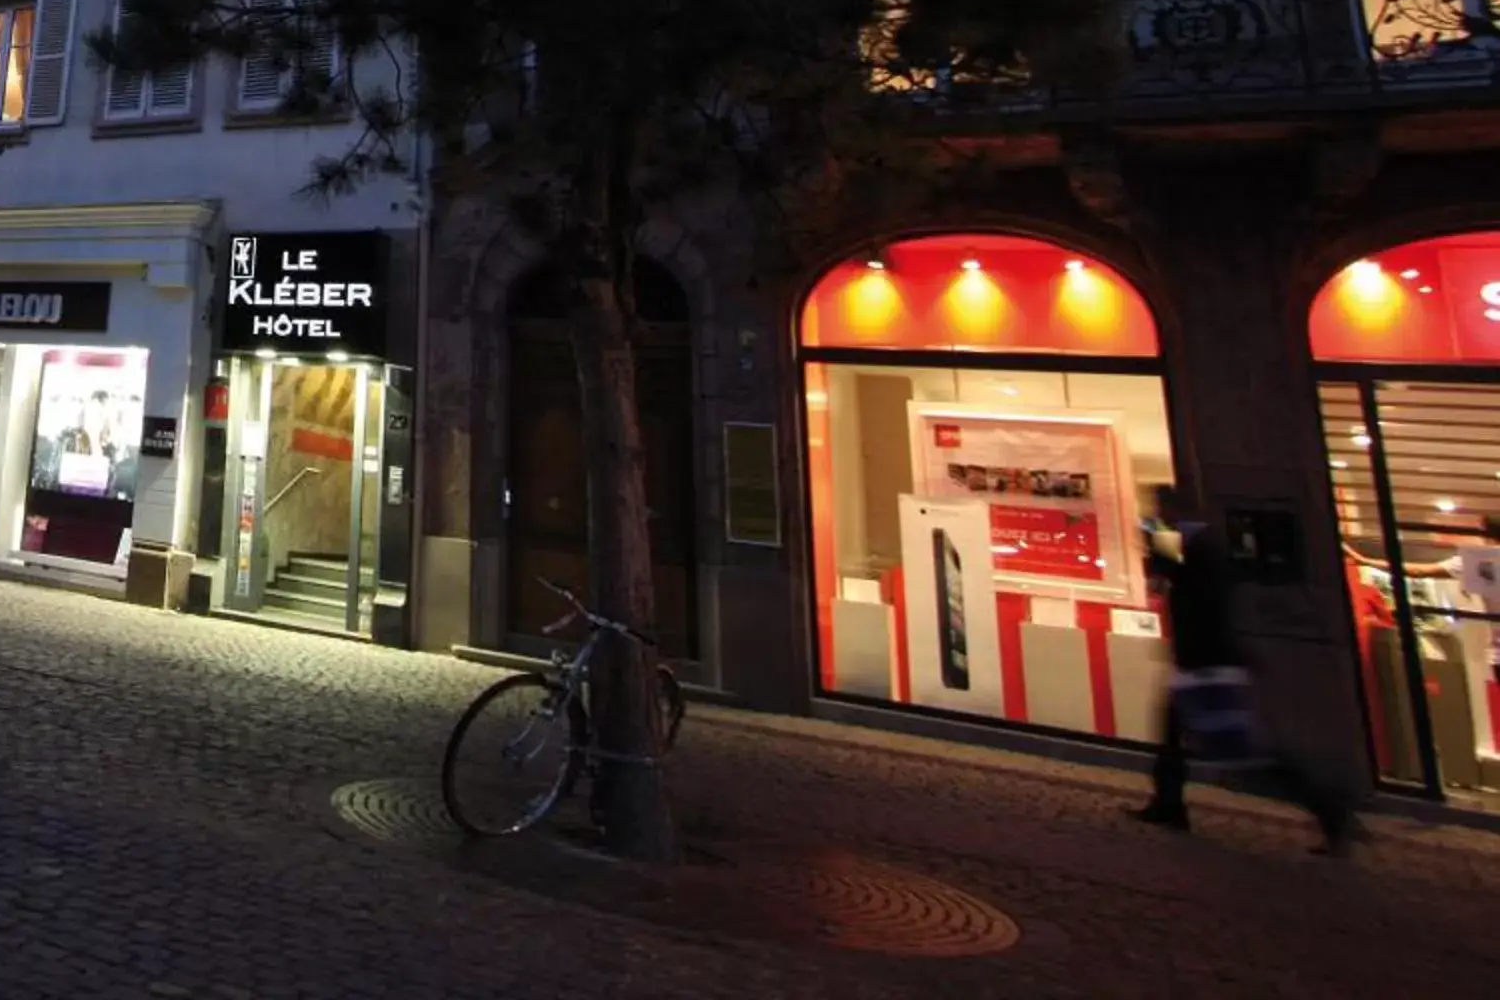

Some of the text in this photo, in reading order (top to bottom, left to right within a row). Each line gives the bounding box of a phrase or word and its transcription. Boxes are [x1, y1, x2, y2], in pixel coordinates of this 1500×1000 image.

[281, 249, 318, 271] LE
[228, 275, 373, 307] KLÉBER
[252, 313, 342, 338] HÔTEL
